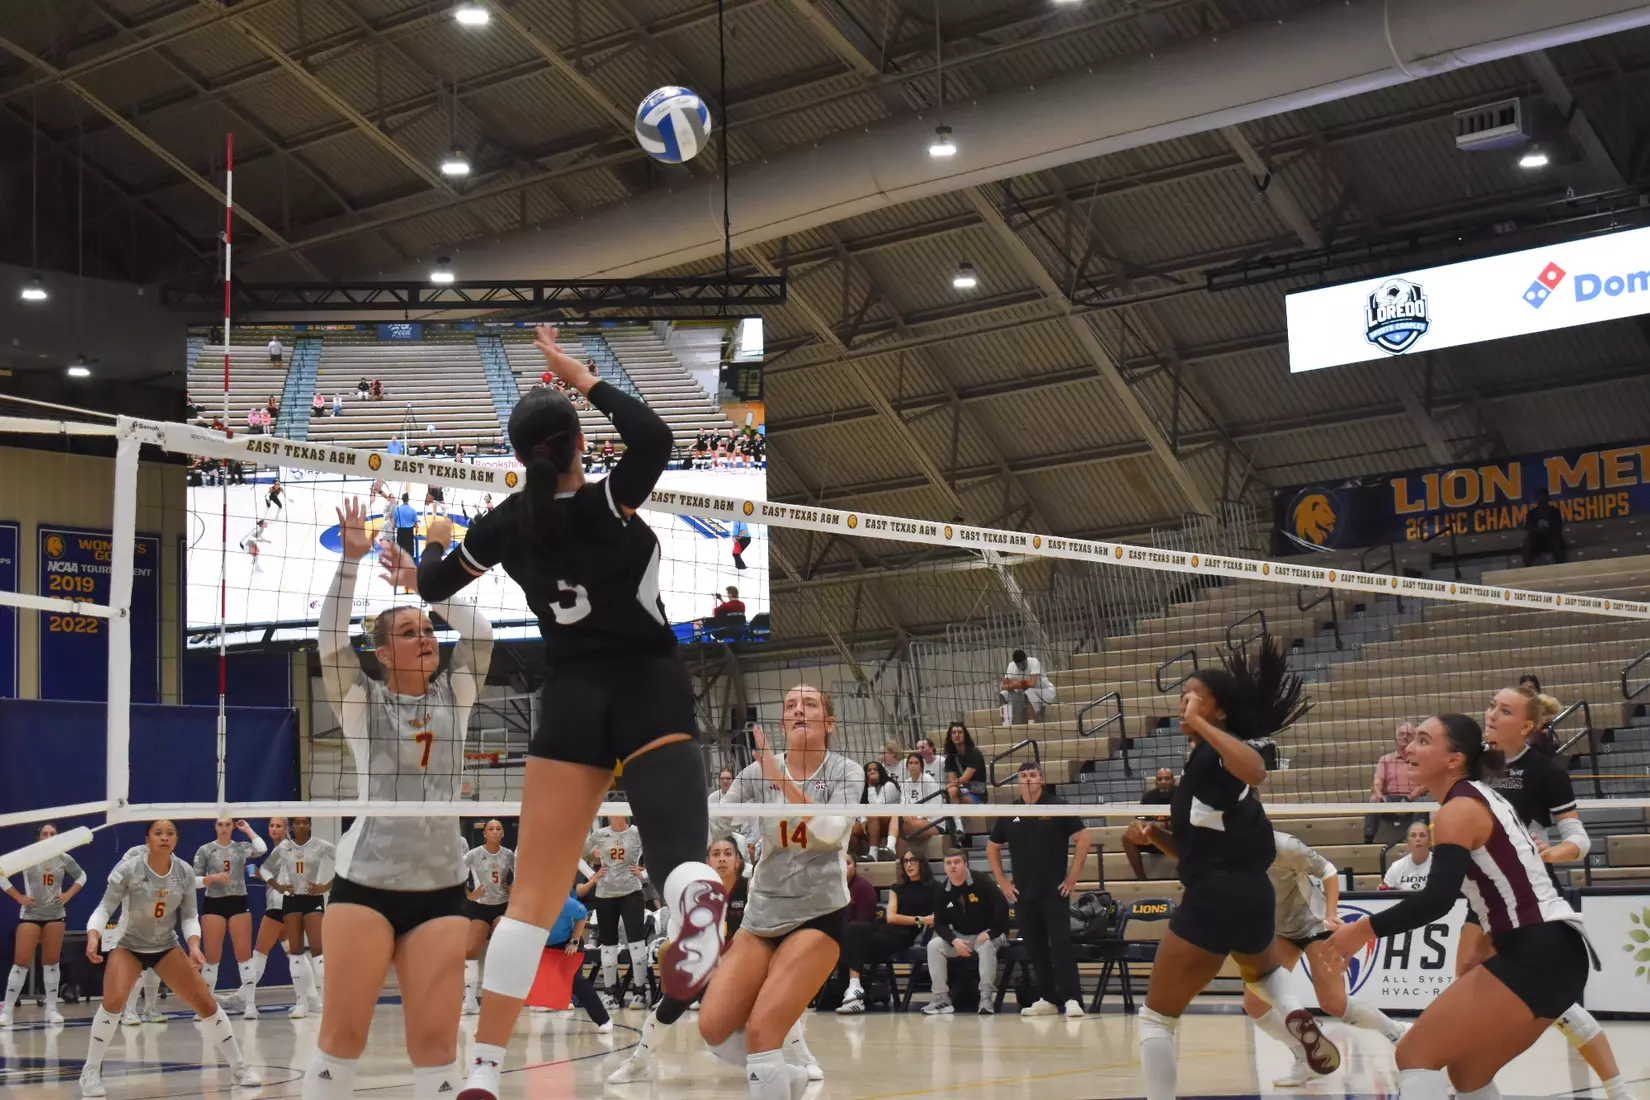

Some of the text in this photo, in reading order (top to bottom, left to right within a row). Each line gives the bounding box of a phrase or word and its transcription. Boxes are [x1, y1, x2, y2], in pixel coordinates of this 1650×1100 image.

[1367, 300, 1425, 327] LOREDO
[246, 439, 356, 466] EAST TEXAS A&M
[394, 459, 495, 483] EAST TEXAS A&M
[1391, 462, 1522, 514] LION
[651, 491, 735, 512] EAST TEXAS A&M
[762, 505, 840, 525] EAST TEXAS A&M
[865, 518, 937, 536] EAST TEXAS A&M
[960, 530, 1027, 546] EAST TEXAS A&M
[78, 539, 148, 554] WOM'S
[1048, 539, 1109, 556] EAST TEXAS A&M
[1128, 550, 1147, 560] EAST
[1148, 553, 1170, 564] TEXAS
[1204, 558, 1221, 568] EAST
[1222, 560, 1243, 571] TEXAS
[47, 561, 152, 576] NCAA TOURENT
[49, 574, 95, 592] 2019
[49, 616, 98, 633] 2022
[415, 730, 433, 768] 7
[779, 819, 808, 849] 14
[610, 848, 625, 860] 22
[223, 860, 231, 872] 3
[295, 861, 305, 873] 11
[43, 874, 54, 886] 16
[491, 871, 499, 884] 5
[1400, 875, 1428, 883] LION
[154, 901, 166, 918] 6
[1132, 903, 1168, 914] LIONS
[1382, 975, 1408, 983] ALL
